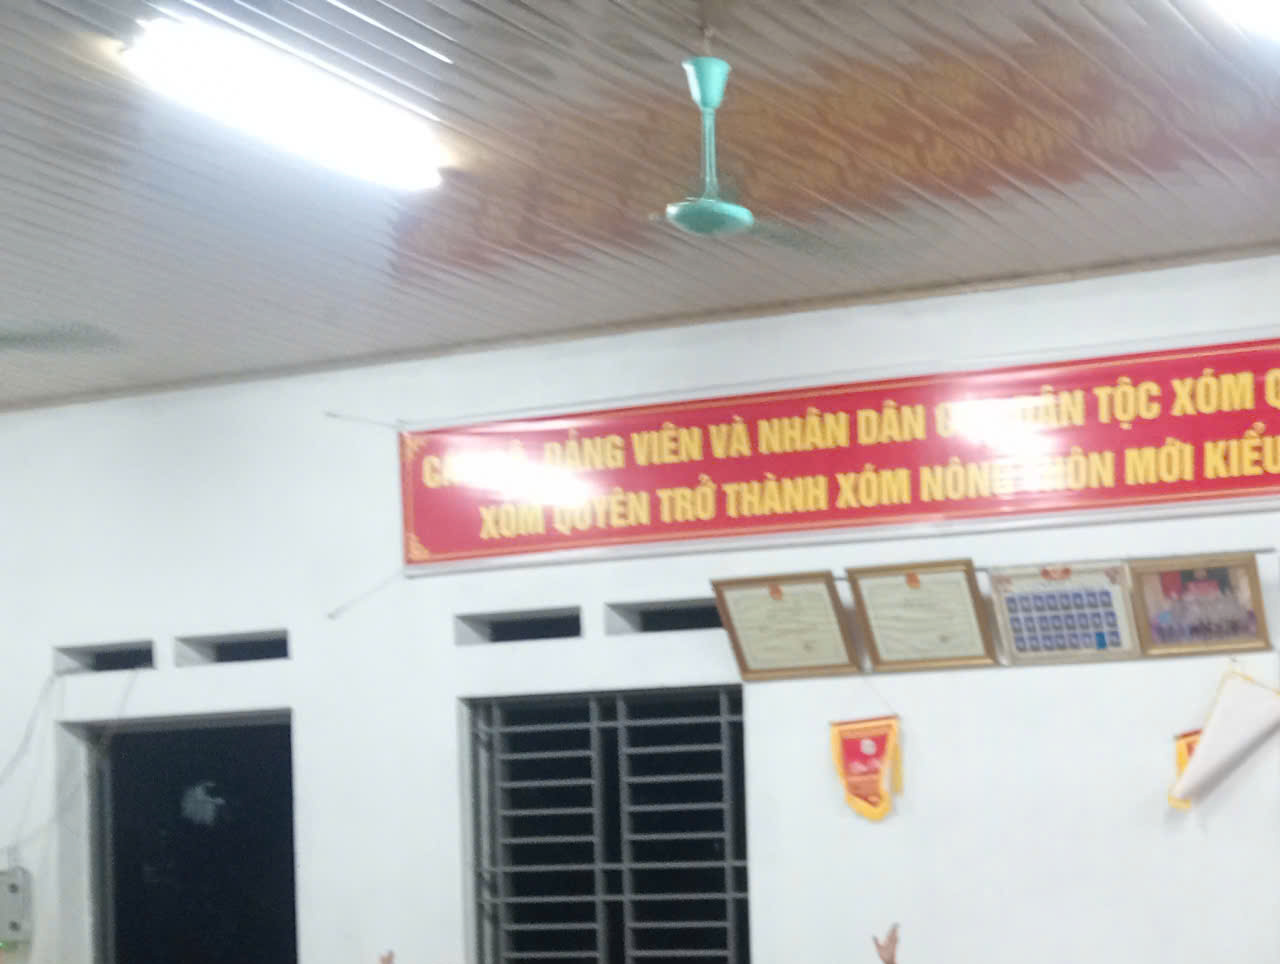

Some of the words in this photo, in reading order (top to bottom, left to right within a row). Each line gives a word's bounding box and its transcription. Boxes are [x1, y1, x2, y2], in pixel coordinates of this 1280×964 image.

[631, 421, 704, 466] VIÊN
[708, 415, 752, 459] VÀ
[758, 406, 850, 454] NHÂN
[856, 399, 927, 446] DÂN
[1093, 376, 1163, 430] TỘC
[1170, 367, 1255, 417] XÓM
[656, 472, 718, 524] TRỞ
[721, 471, 829, 519] THÀNH
[835, 462, 912, 510] XÓM
[1124, 436, 1195, 486] MỚI
